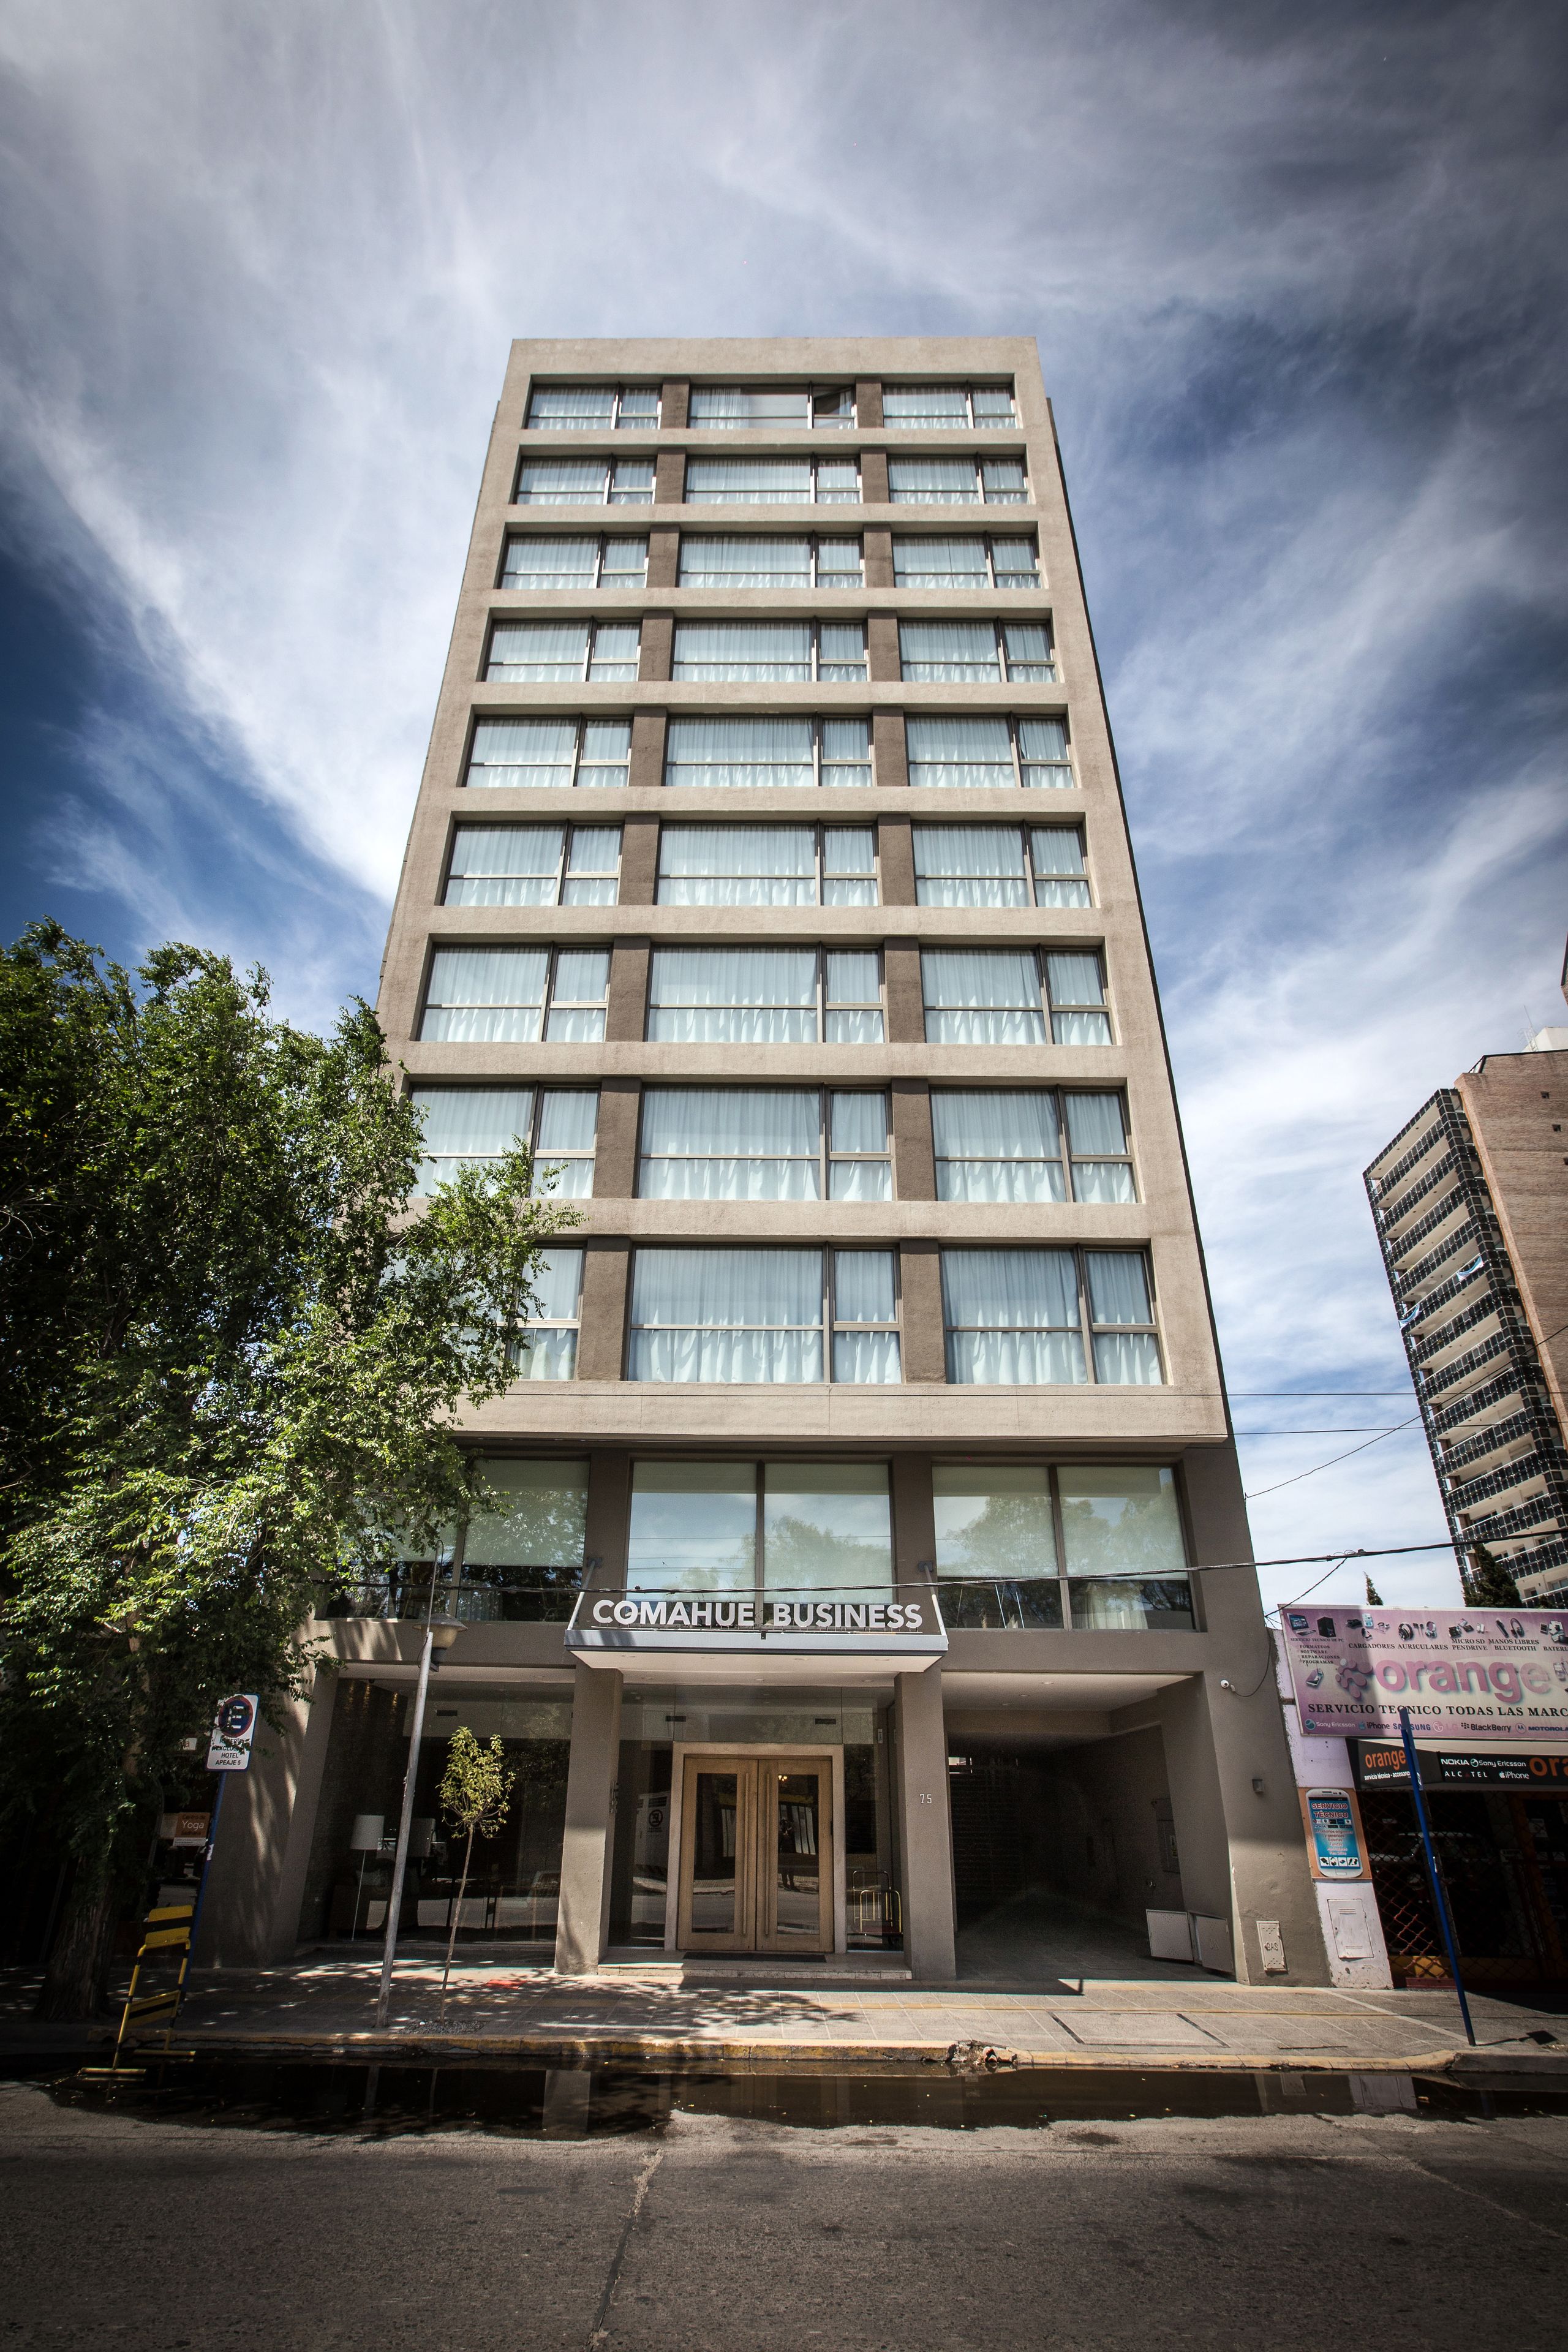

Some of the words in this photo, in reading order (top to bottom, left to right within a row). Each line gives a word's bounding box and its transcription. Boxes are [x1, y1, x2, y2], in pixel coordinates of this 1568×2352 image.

[592, 1599, 755, 1626] COMAHUE
[773, 1603, 922, 1629] BUSINESS
[1376, 1659, 1550, 1703] orange
[1308, 1703, 1374, 1714] SERVICIO
[1446, 1706, 1493, 1716] TODAS
[1498, 1706, 1523, 1716] LAS
[1527, 1707, 1568, 1717] MARC
[1471, 1724, 1511, 1733] BlackBerry
[1365, 1750, 1406, 1770] orange
[1529, 1757, 1568, 1777] or
[919, 1793, 932, 1804] 75
[182, 1820, 204, 1831] Yoga
[1265, 1942, 1278, 1951] GAS
